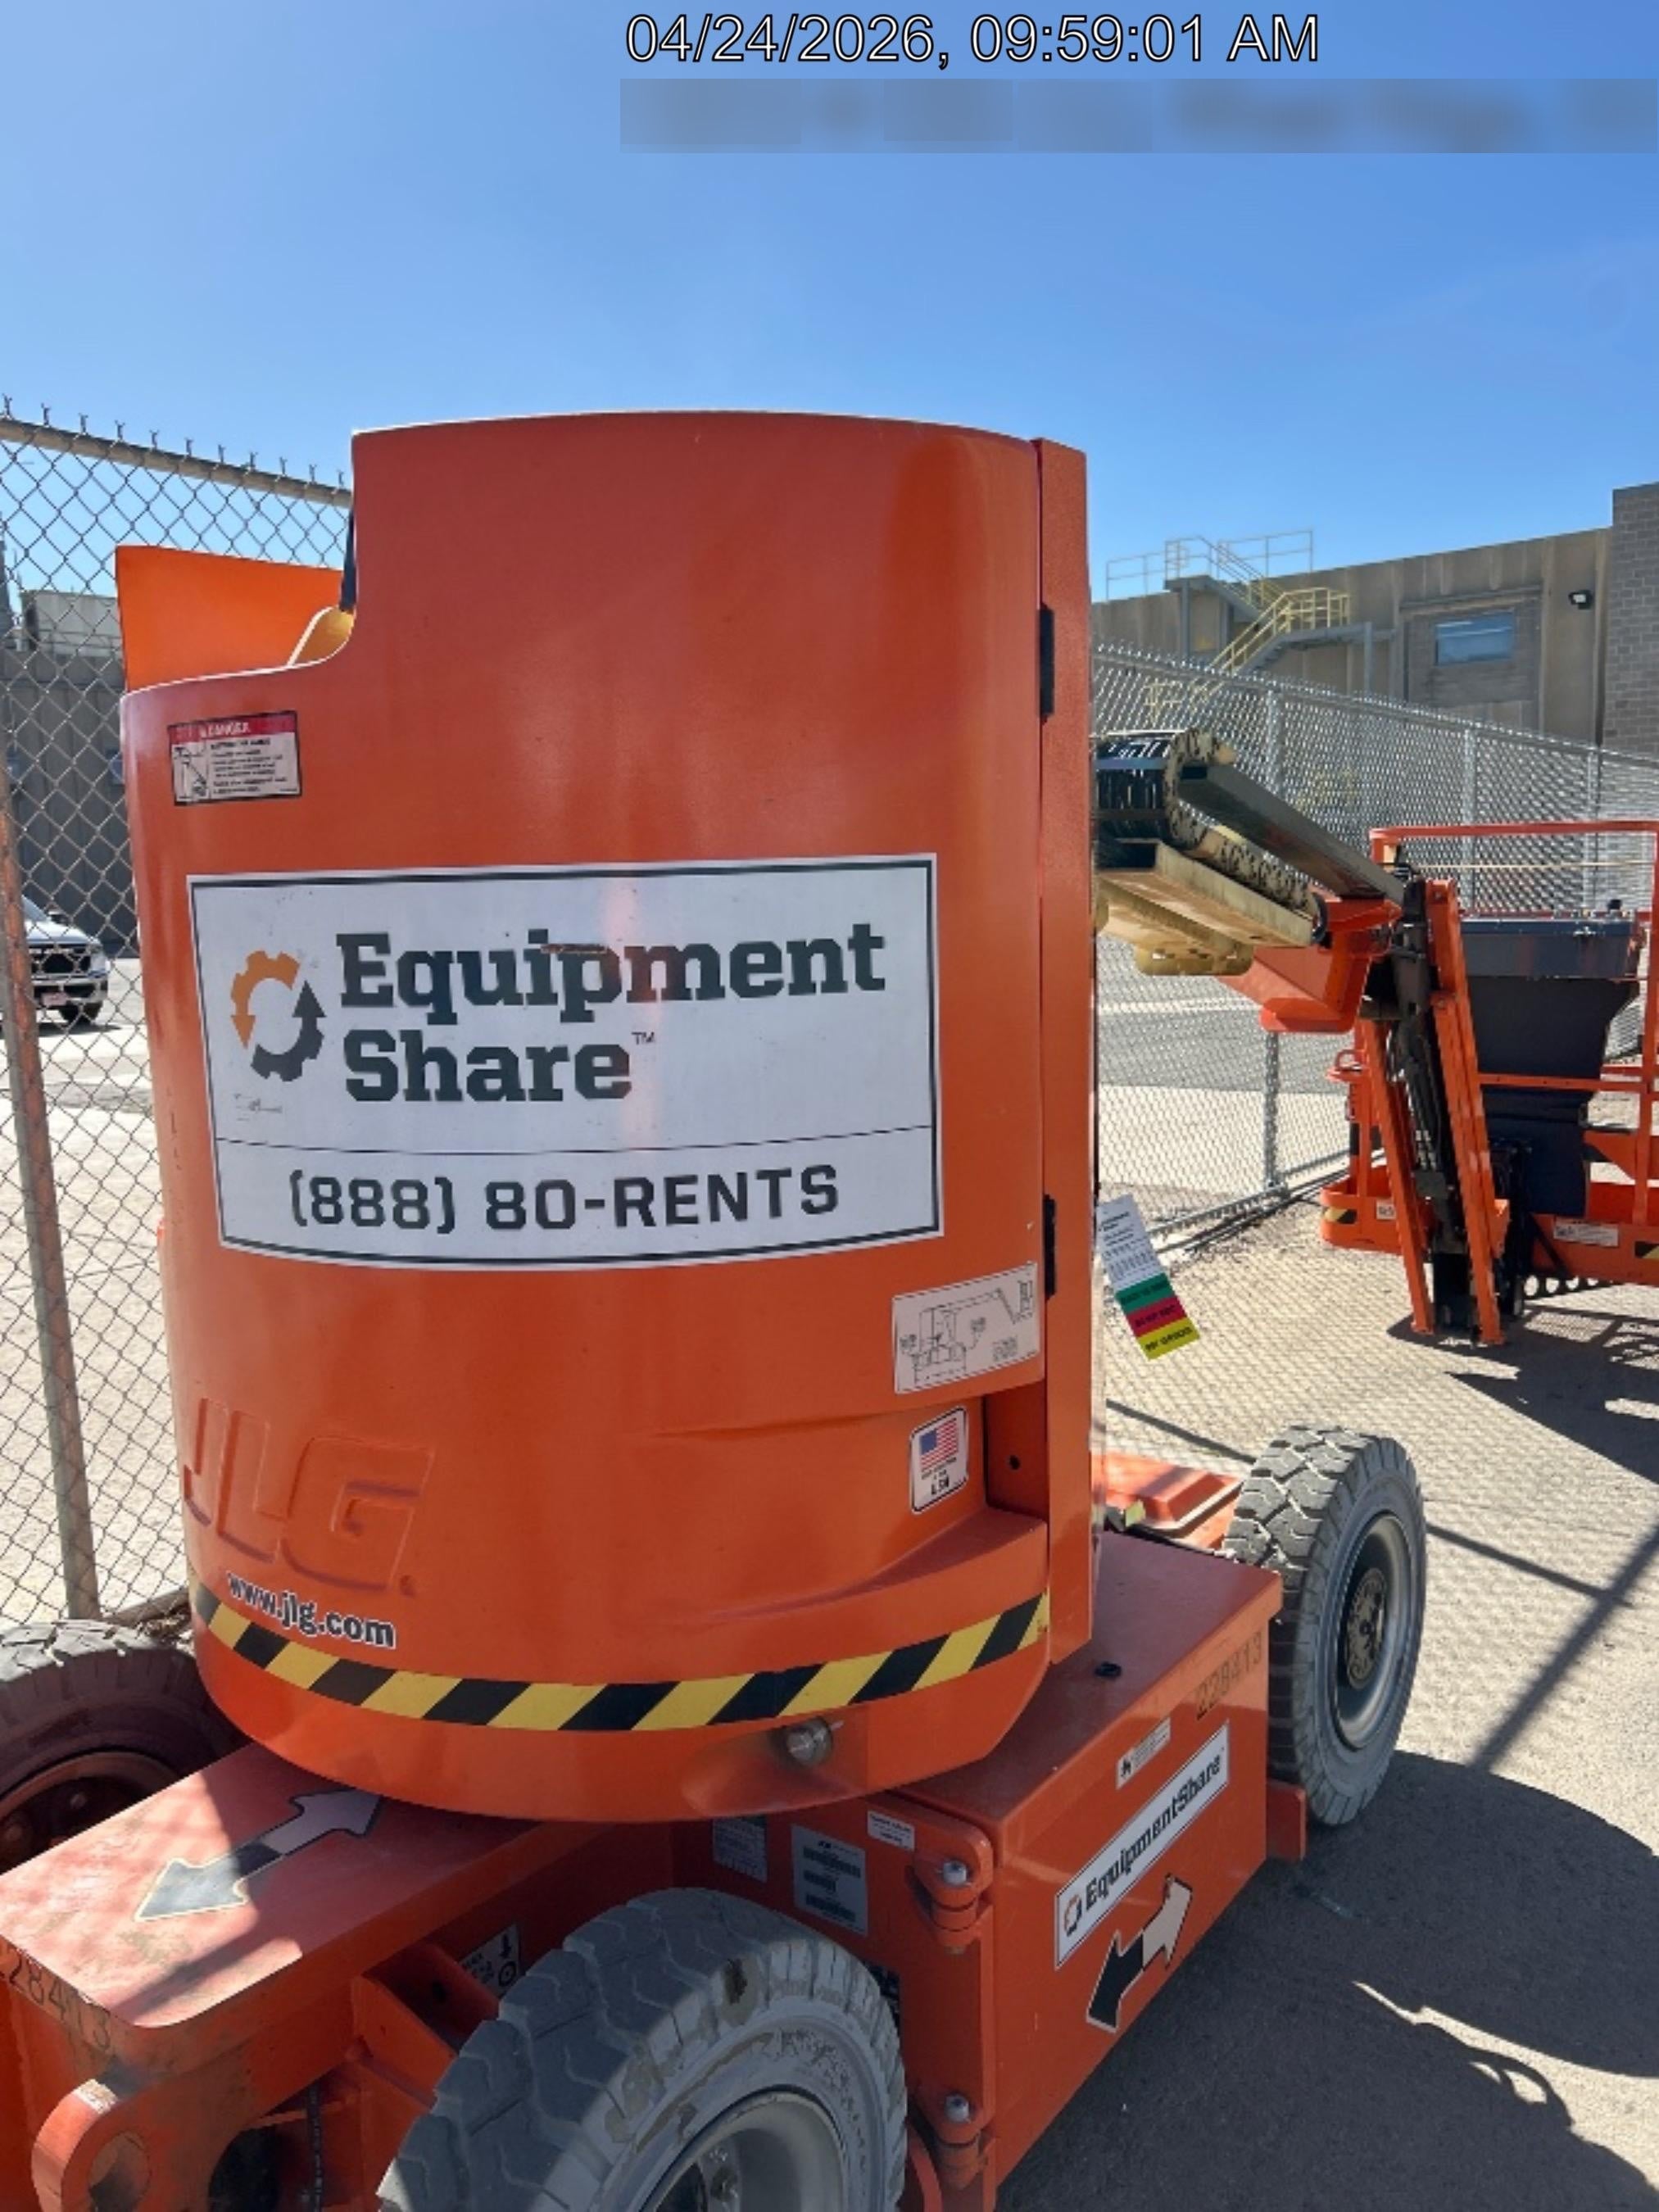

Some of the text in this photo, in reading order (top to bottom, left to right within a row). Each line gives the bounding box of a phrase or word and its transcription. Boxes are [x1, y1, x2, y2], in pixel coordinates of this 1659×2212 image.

[336, 923, 886, 1025] Equipment
[343, 1029, 632, 1102] Share
[289, 1164, 839, 1234] (888) 80-RENTS
[183, 1397, 437, 1593] JLG
[226, 1571, 397, 1652] www.jlg.com
[1086, 1753, 1221, 1912] EquipmentShare
